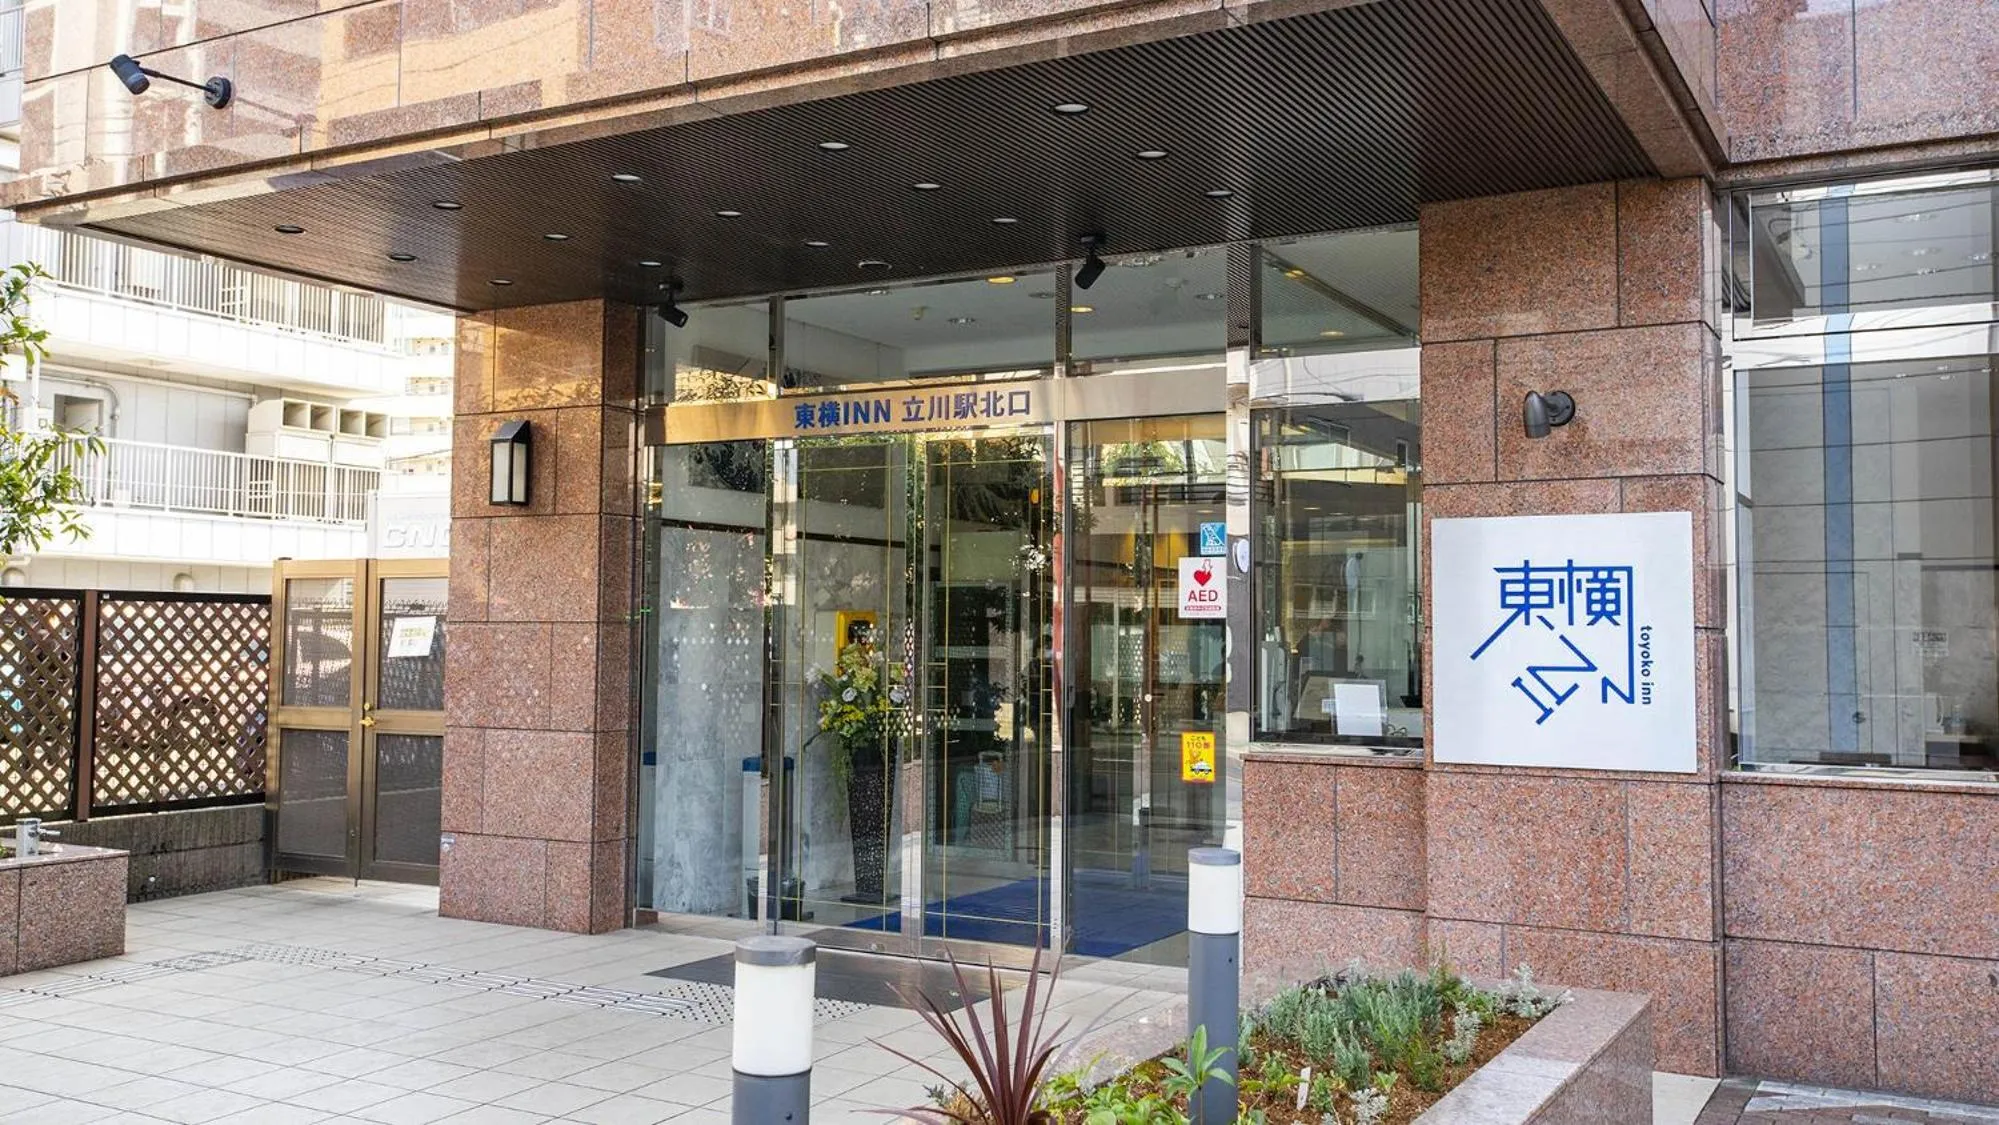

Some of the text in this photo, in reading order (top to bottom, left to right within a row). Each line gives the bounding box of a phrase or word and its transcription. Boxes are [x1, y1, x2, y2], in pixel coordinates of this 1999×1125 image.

[794, 391, 1030, 428] 東横INN 立川駅北口
[1187, 590, 1218, 602] AED
[1638, 625, 1653, 705] toyoko inn
